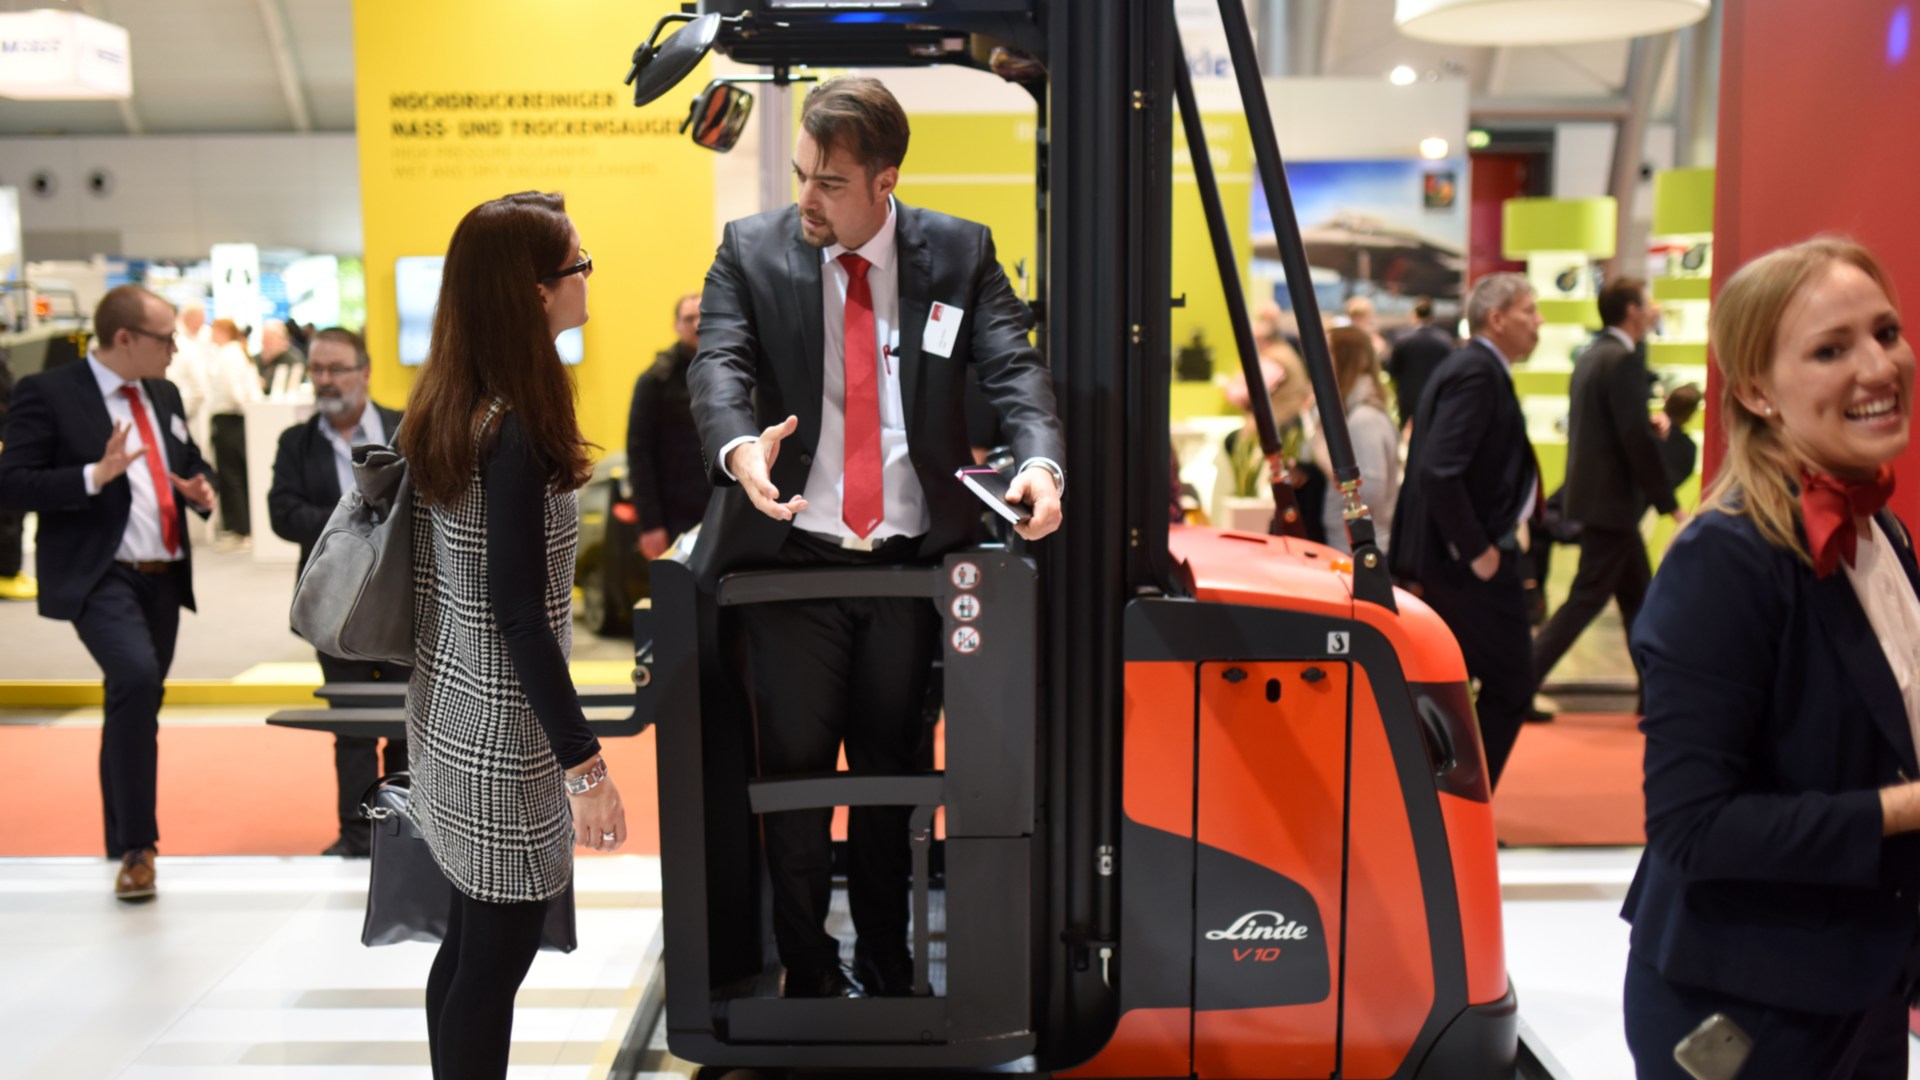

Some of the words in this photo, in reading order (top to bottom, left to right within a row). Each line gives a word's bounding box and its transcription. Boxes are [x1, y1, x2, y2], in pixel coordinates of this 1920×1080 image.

[389, 91, 617, 112] HOCHDRUCKREINIGER
[458, 119, 503, 138] UND
[1205, 910, 1308, 940] Linde
